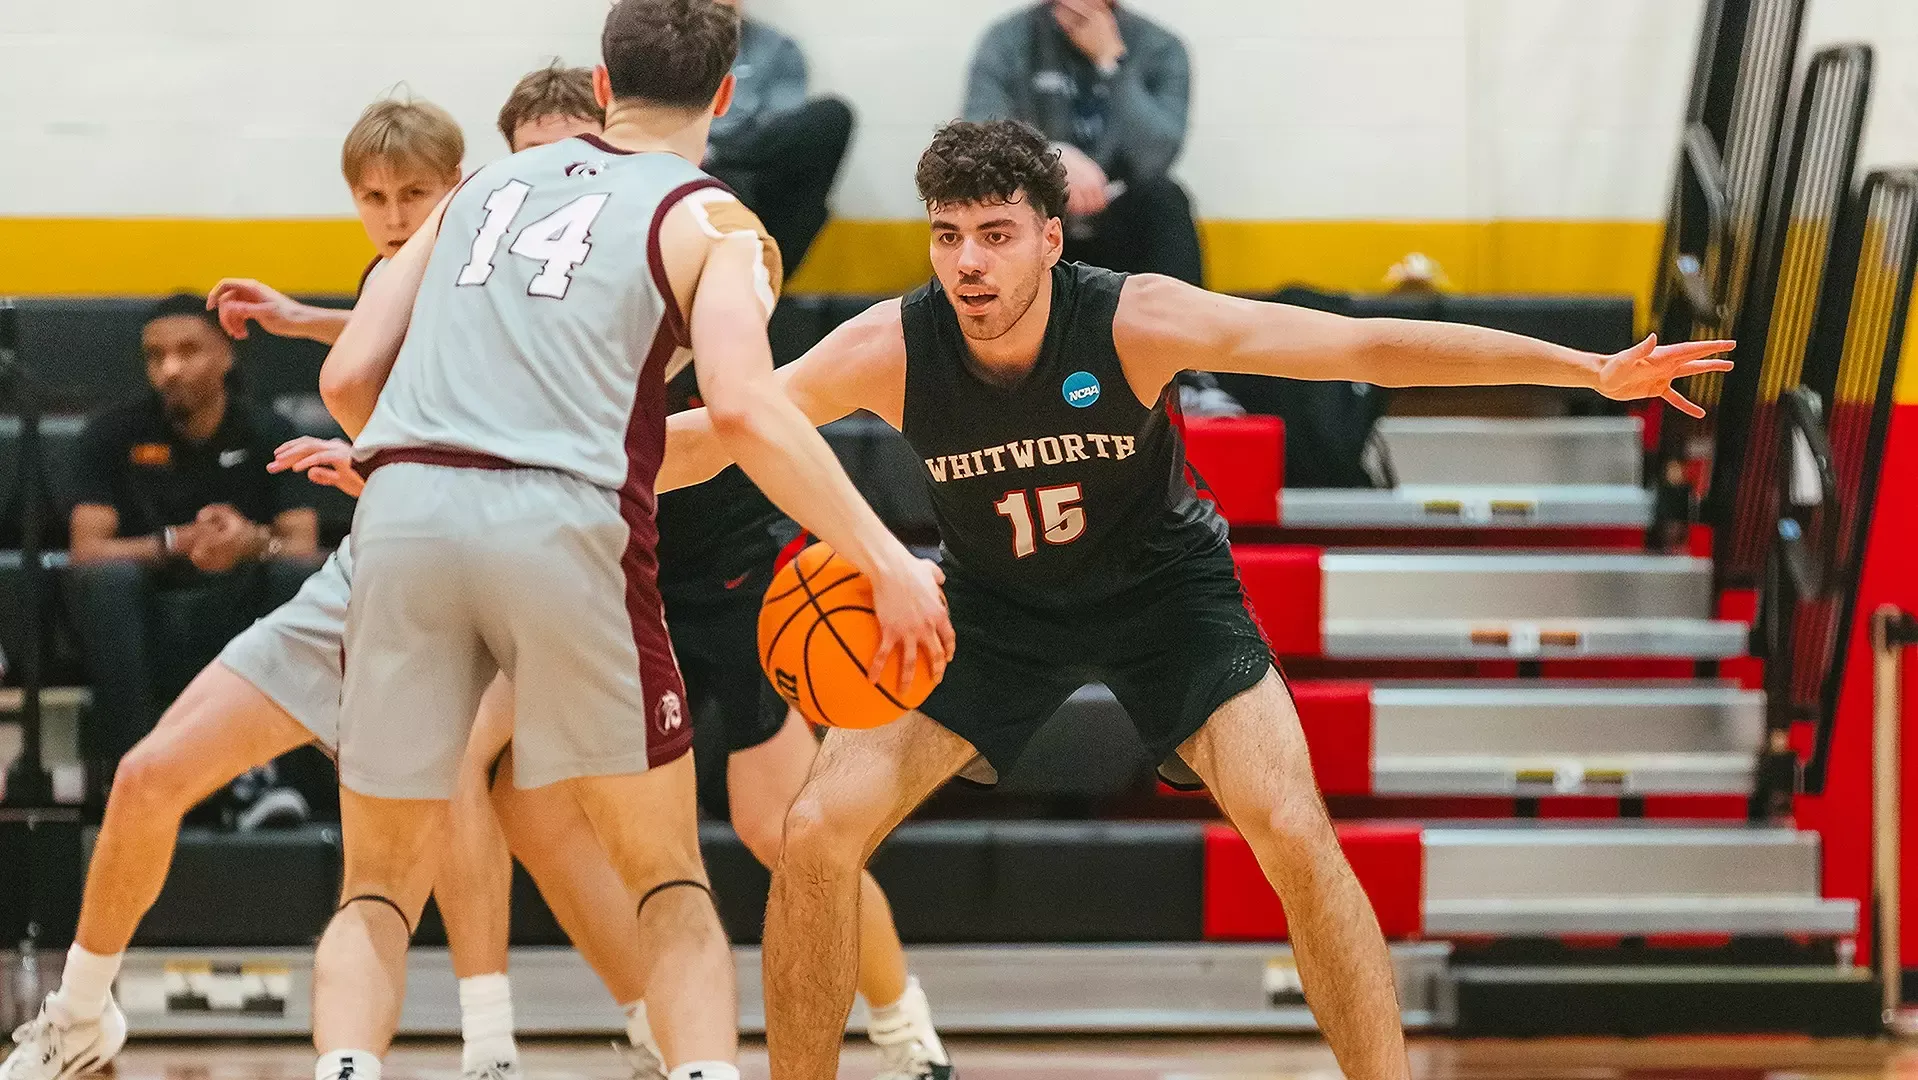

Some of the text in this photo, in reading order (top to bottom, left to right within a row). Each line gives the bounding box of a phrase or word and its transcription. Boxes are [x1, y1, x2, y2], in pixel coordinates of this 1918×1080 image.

[455, 178, 612, 300] 14
[1069, 385, 1100, 402] NCAA
[924, 433, 1136, 483] WHITWORTH
[993, 482, 1087, 558] 15
